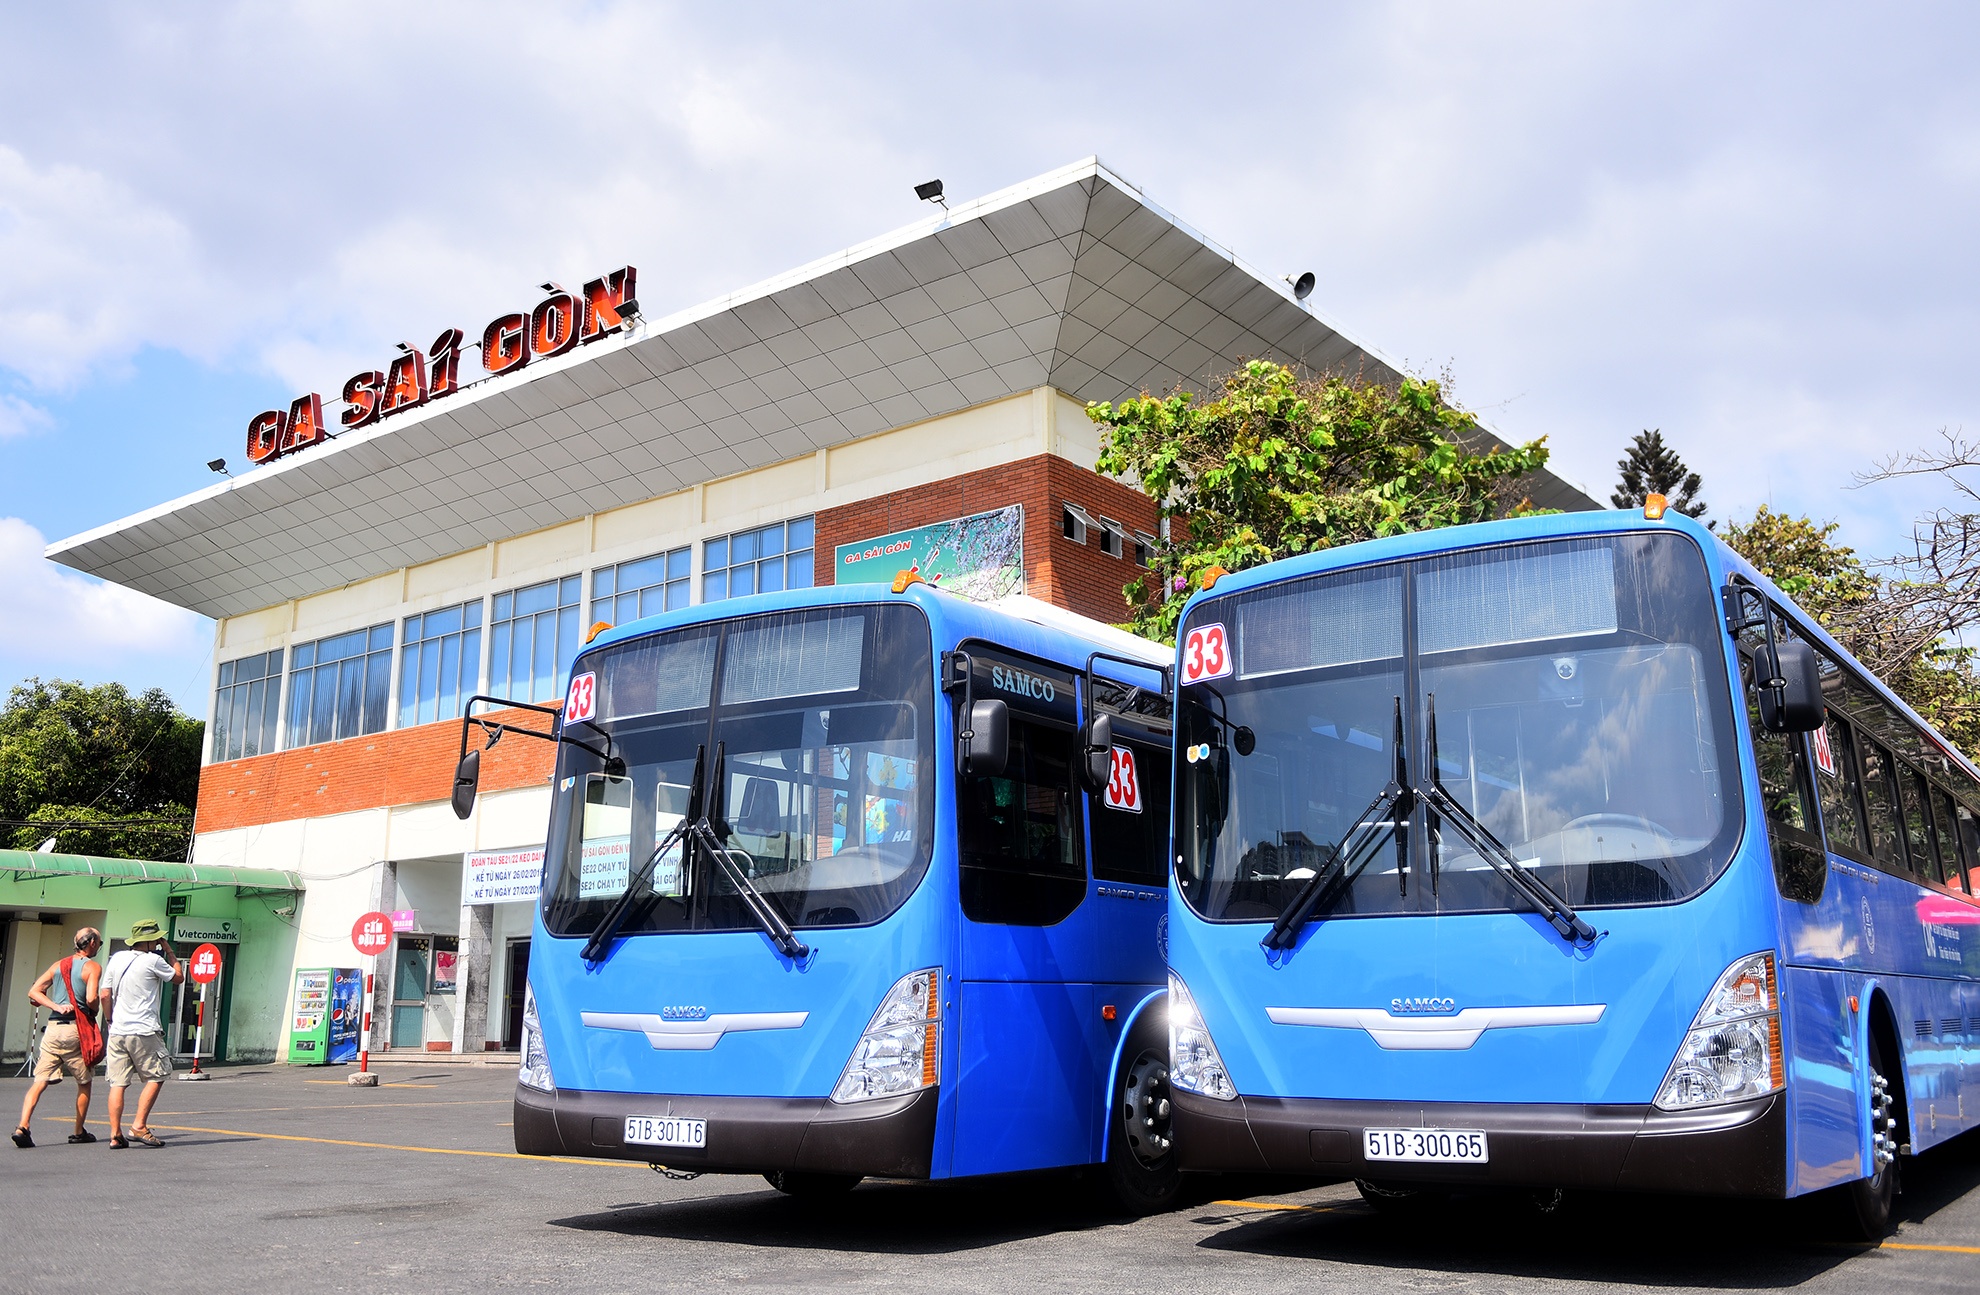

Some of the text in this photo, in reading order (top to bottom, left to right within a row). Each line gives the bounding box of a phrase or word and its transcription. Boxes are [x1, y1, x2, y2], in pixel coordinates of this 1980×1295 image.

[246, 391, 326, 465] GA
[481, 265, 637, 375] GÒN
[845, 540, 912, 564] GA SÀI GÒN
[1187, 628, 1223, 679] 33
[992, 666, 1055, 702] SAMCO
[569, 676, 593, 720] 33
[1109, 748, 1136, 807] 33
[471, 856, 485, 867] ĐOÀN
[487, 854, 497, 866] TÀU
[498, 854, 518, 865] SE21/22
[598, 843, 611, 856] GÒN
[495, 869, 511, 881] NGÀY
[582, 863, 597, 874] SE22
[597, 861, 615, 875] CHẠY
[617, 858, 627, 871] TỪ
[494, 885, 511, 897] NGÀY
[512, 885, 540, 896] 27/02/201
[580, 881, 595, 891] SE21
[597, 878, 616, 891] CHẠY
[617, 875, 627, 888] TỪ
[1097, 887, 1135, 899] SAMCO
[1138, 891, 1161, 902] CITY
[178, 929, 237, 940] Vietcombank
[375, 934, 386, 945] XE
[663, 1006, 706, 1019] SAMCO
[1391, 997, 1455, 1012] SAMCO
[628, 1119, 703, 1143] 51B-301.16
[1369, 1133, 1482, 1158] 51B-300.65
